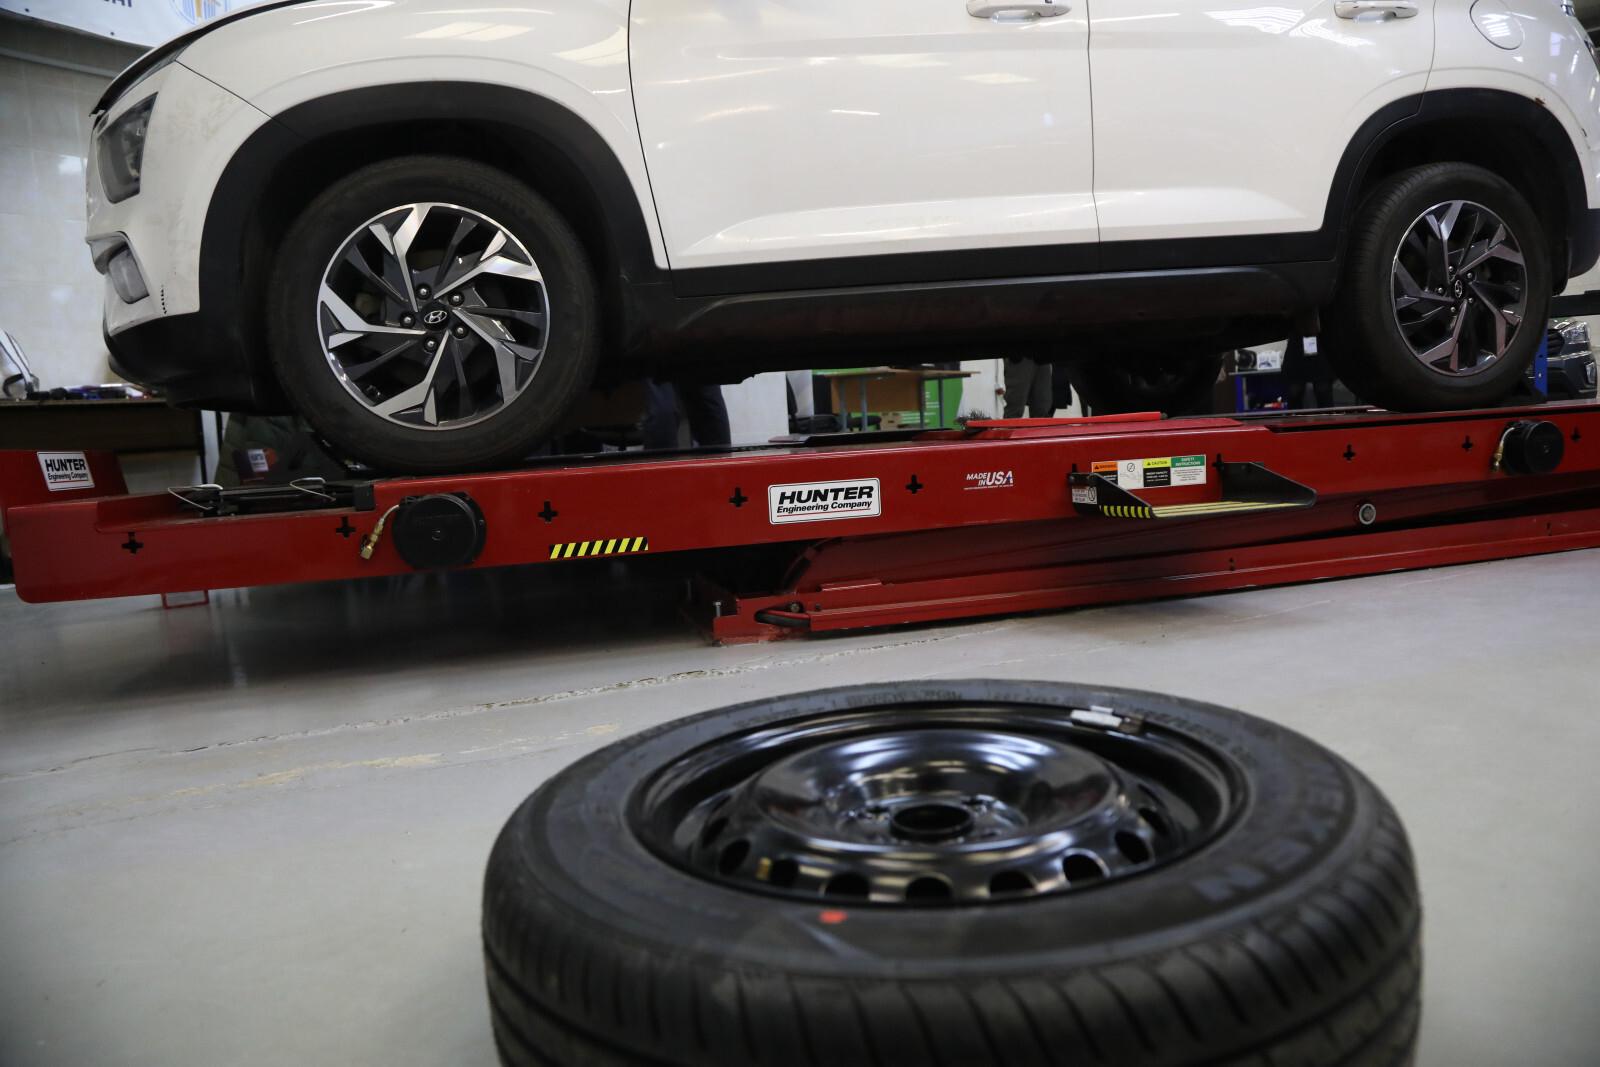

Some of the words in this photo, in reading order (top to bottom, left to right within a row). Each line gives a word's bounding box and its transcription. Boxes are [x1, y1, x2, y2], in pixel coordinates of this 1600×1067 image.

[45, 458, 87, 472] HUNTER
[47, 472, 71, 481] Engineering
[71, 471, 89, 480] Company
[966, 472, 988, 481] MADE
[986, 470, 1014, 485] USA
[778, 485, 874, 505] HUNTER
[776, 503, 829, 514] Engineering
[831, 500, 872, 509] Company
